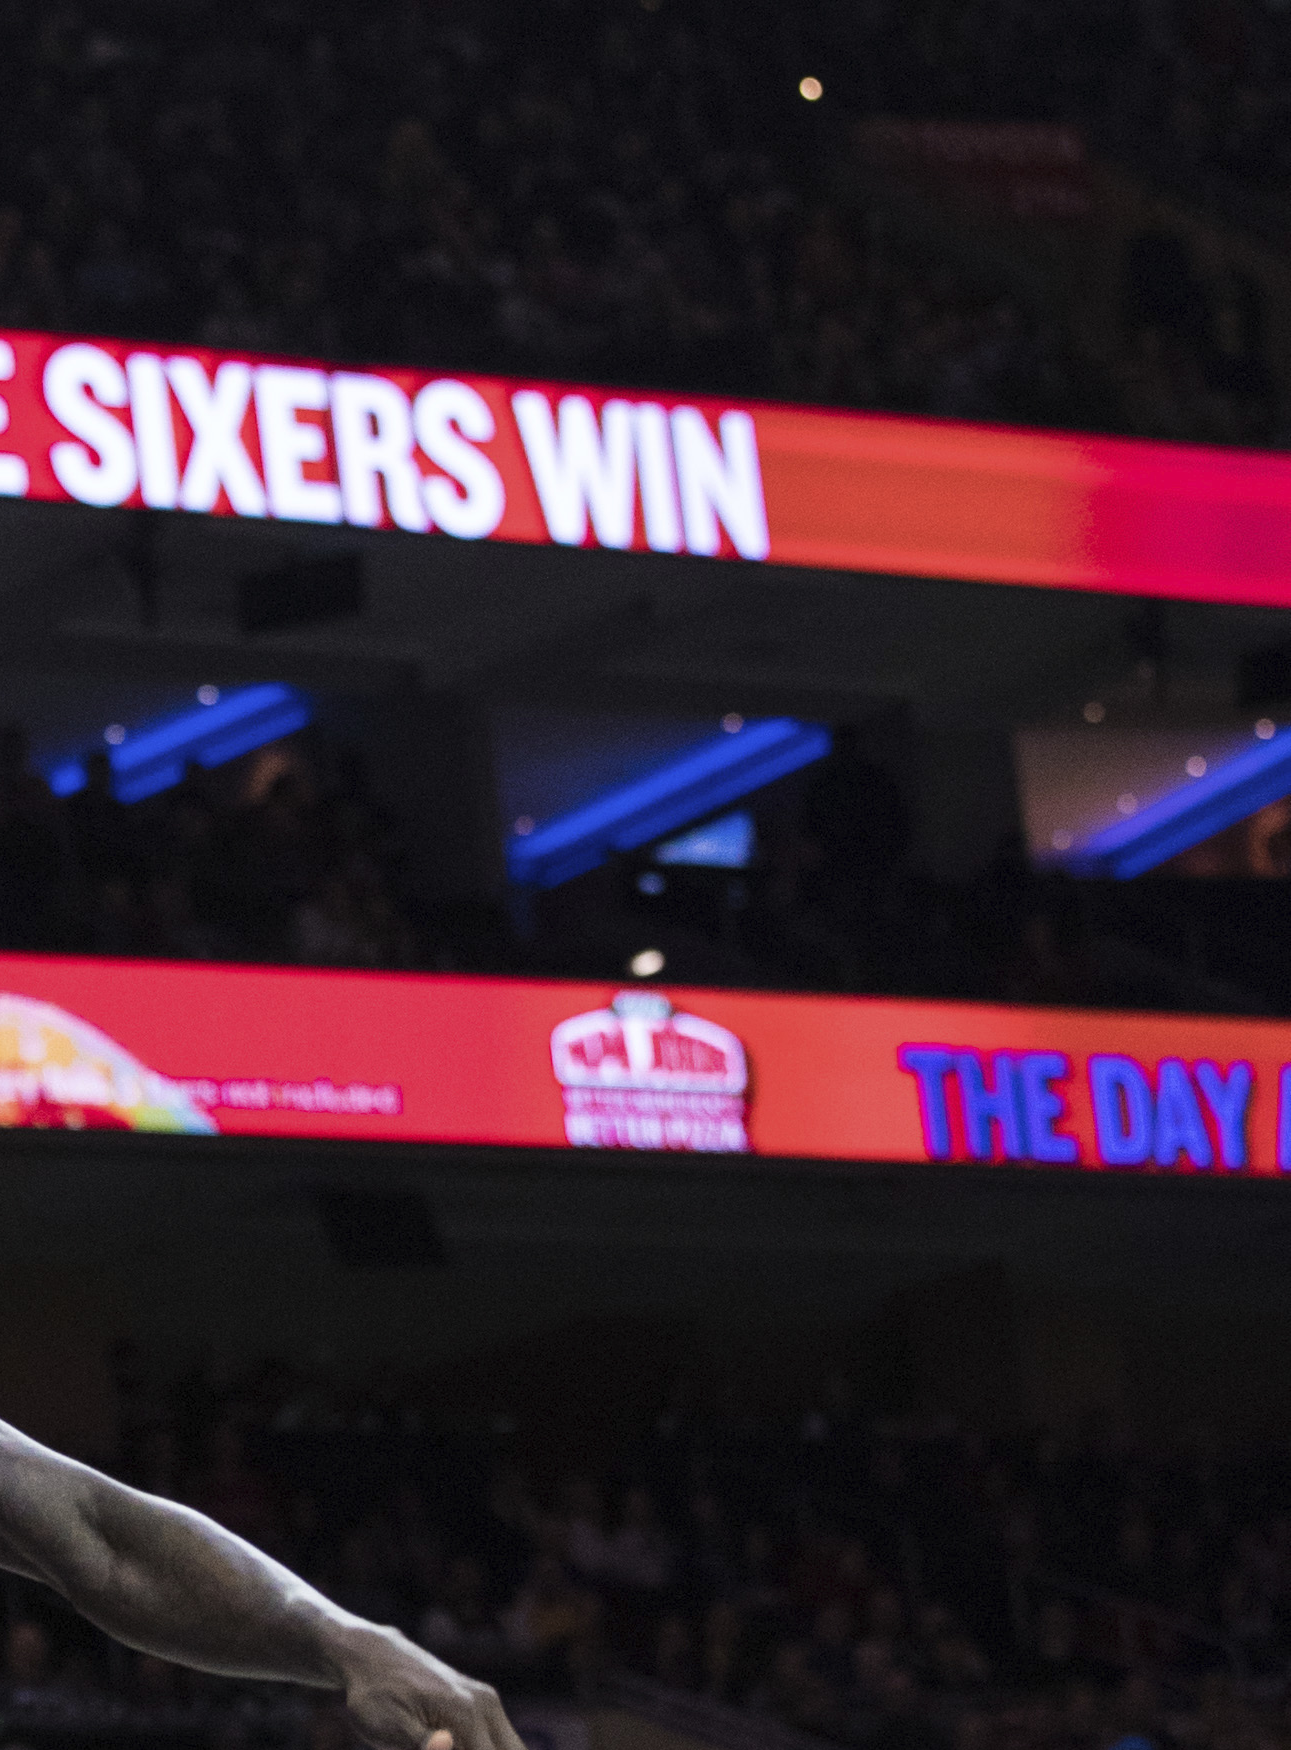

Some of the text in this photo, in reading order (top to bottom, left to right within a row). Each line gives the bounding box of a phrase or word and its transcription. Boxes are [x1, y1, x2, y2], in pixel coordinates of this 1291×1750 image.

[42, 341, 506, 541] SIXERS
[511, 388, 771, 562] WIN
[899, 1042, 1078, 1164] THE
[1088, 1053, 1256, 1171] DAY
